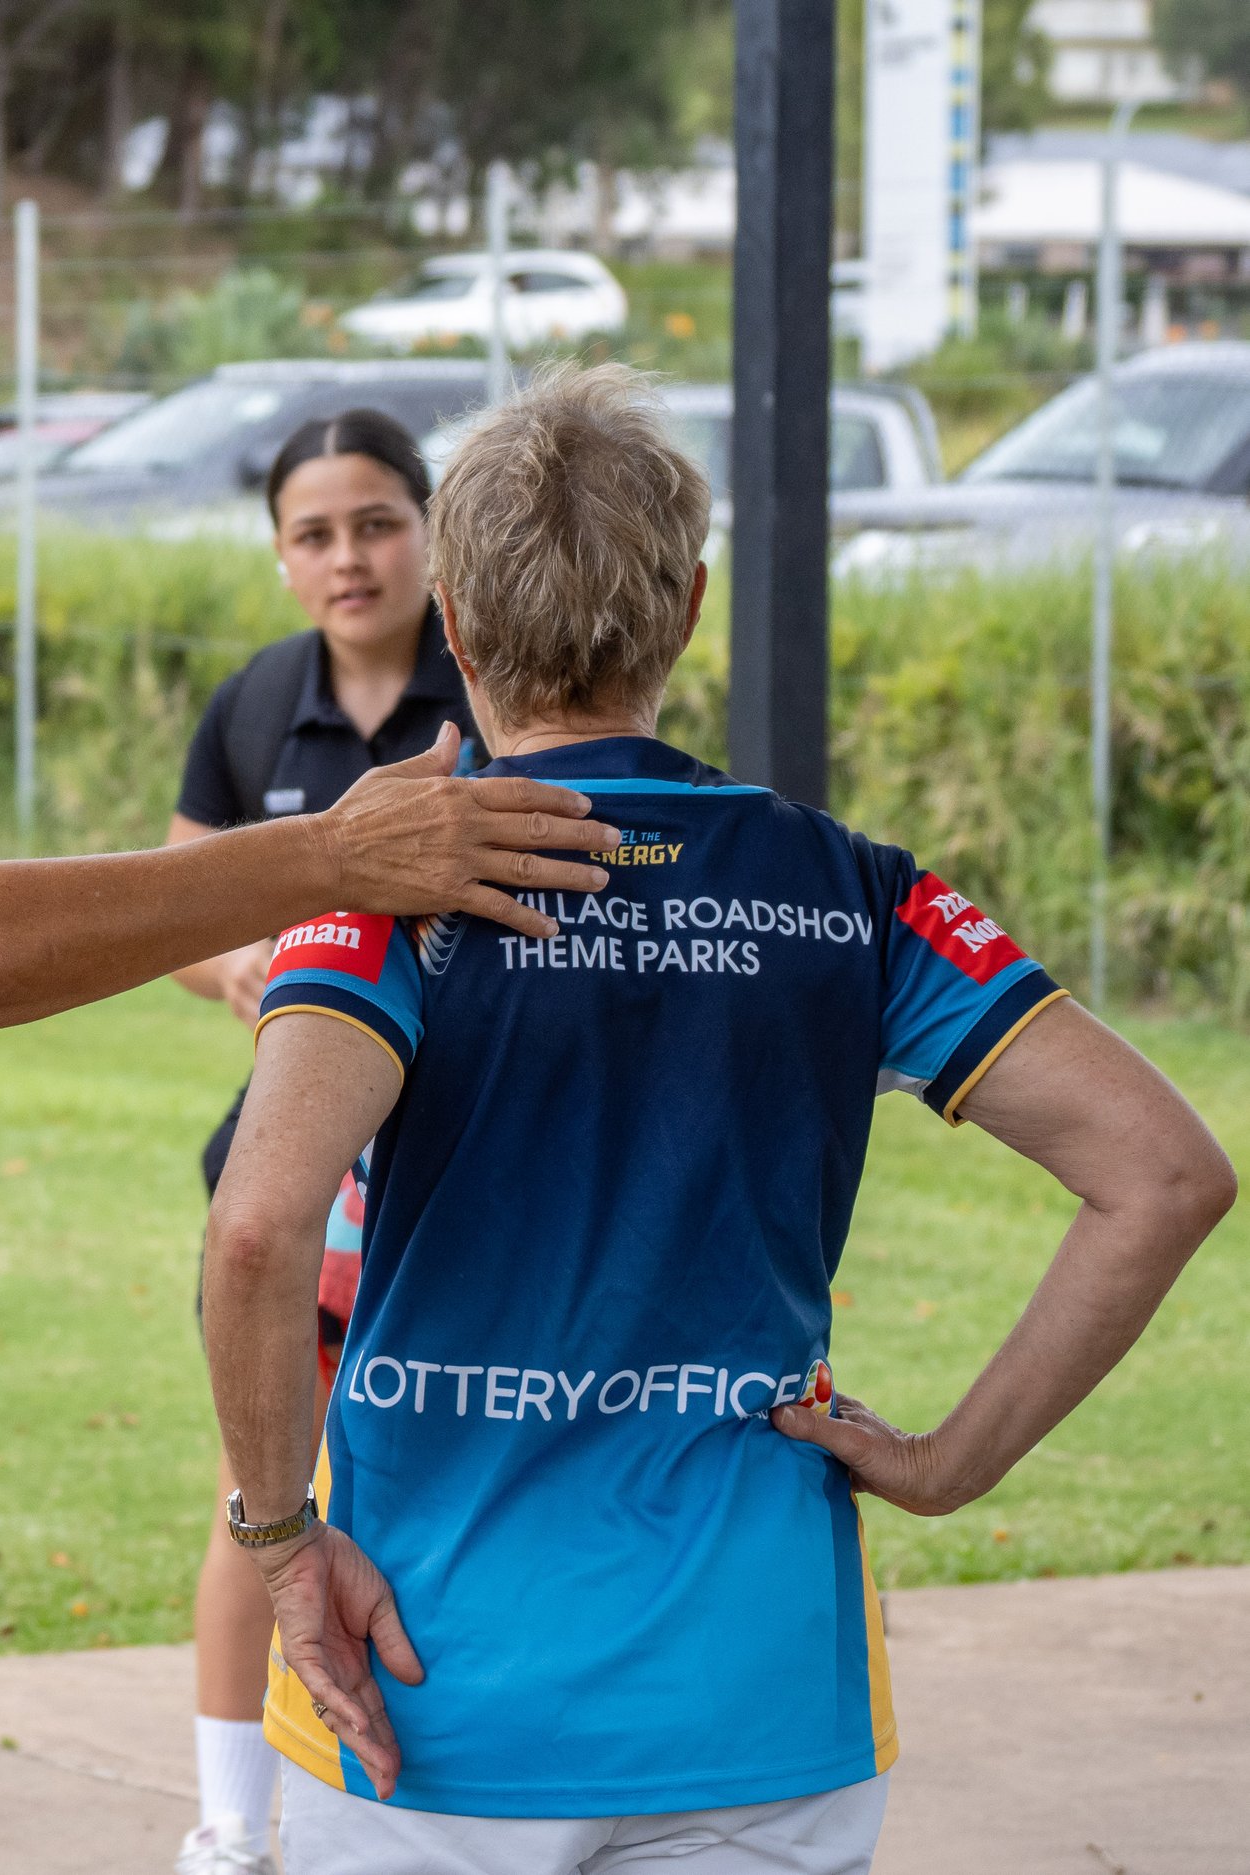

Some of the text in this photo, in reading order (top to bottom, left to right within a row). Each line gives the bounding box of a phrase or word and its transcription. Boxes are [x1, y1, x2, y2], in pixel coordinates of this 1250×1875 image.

[641, 831, 662, 842] THE
[498, 935, 760, 976] THEME PARKS
[349, 1350, 801, 1421] LOTTERY OFFICE
